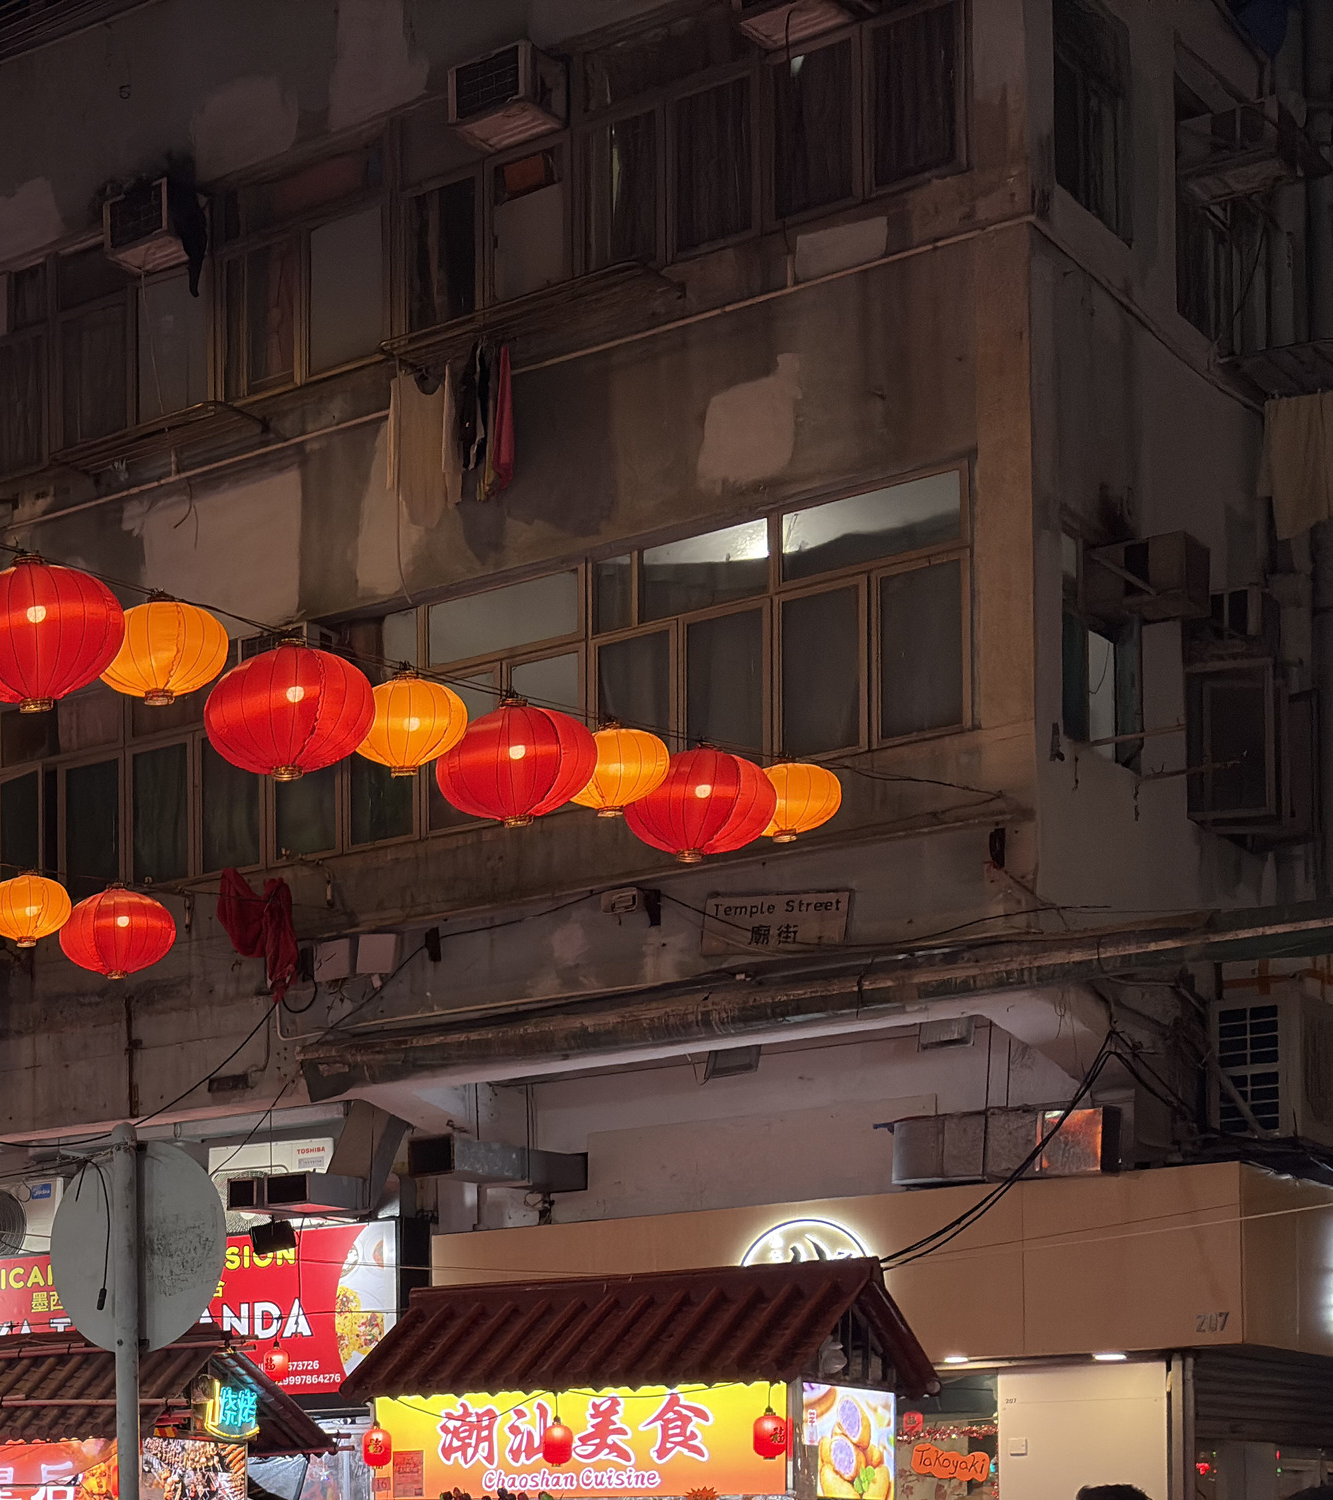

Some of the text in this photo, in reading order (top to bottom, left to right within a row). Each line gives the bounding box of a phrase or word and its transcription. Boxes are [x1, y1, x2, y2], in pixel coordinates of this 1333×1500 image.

[714, 899, 841, 917] Temple Street
[748, 924, 798, 945] 廟街
[297, 1146, 325, 1155] TOSHIBA
[224, 1245, 297, 1271] SION
[199, 1298, 314, 1340] ANDA
[1196, 1312, 1229, 1333] 207
[482, 1466, 661, 1490] Chaoshan Cuisine
